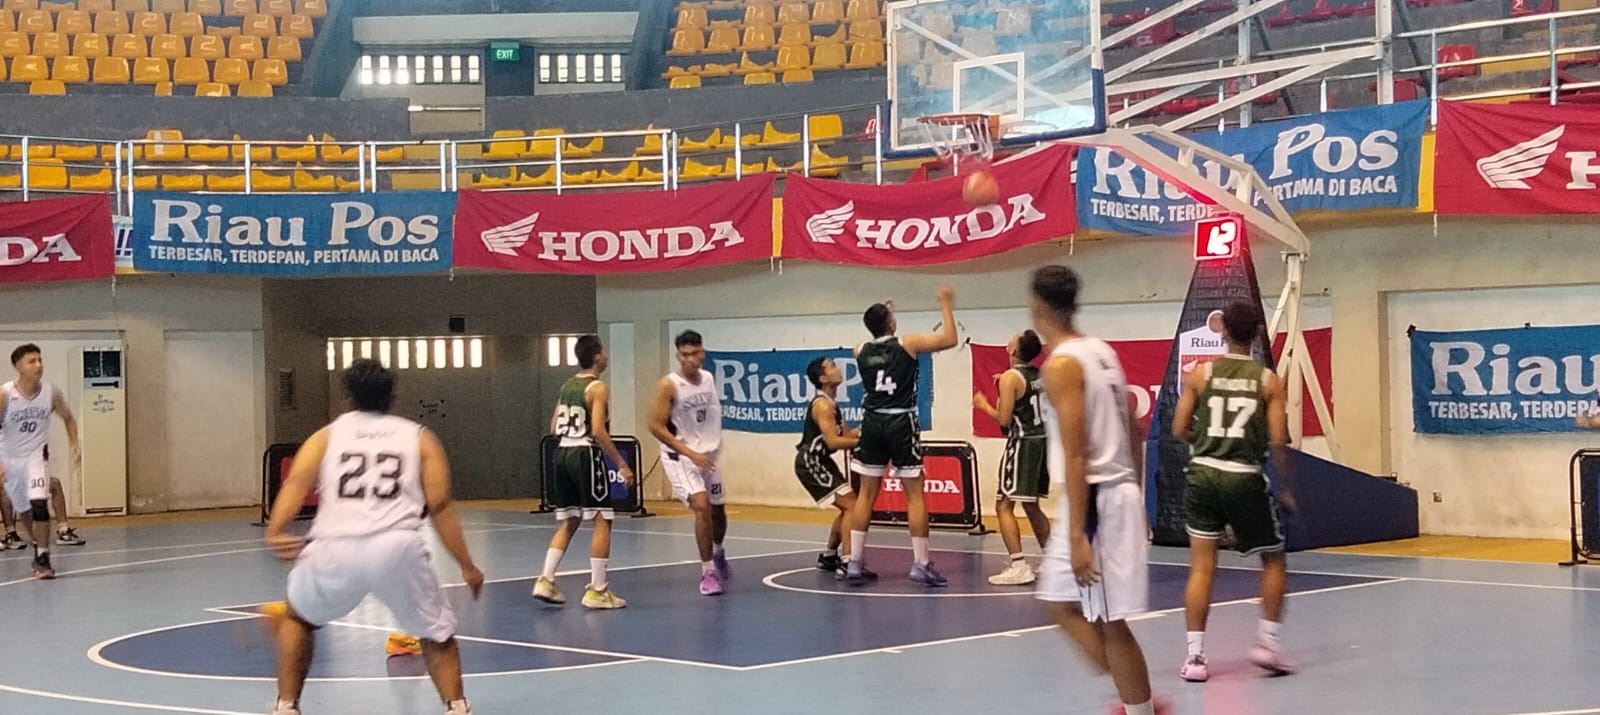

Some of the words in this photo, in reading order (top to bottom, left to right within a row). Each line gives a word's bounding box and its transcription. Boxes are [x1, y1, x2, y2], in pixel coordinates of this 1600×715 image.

[496, 49, 514, 60] EXIT
[1268, 123, 1399, 180] Pos
[1090, 199, 1165, 224] TERBESAR,
[1254, 178, 1324, 206] PRTAMA
[1328, 178, 1345, 196] DI
[1349, 175, 1398, 195] BACA
[150, 199, 307, 246] Riau
[327, 201, 439, 246] Pos
[855, 193, 1046, 250] HONDA
[1206, 221, 1237, 255] 12
[148, 245, 228, 264] TERBESAR,
[230, 249, 310, 266] TERDEPAN,
[313, 248, 381, 264] PERTAMA
[383, 249, 399, 263] DI
[402, 247, 439, 263] BACA
[538, 220, 744, 262] HONDA
[1191, 337, 1219, 348] Riau
[713, 359, 816, 403] Riau
[875, 370, 897, 395] 4
[1429, 341, 1600, 396] Riau
[555, 404, 587, 438] 23
[766, 407, 807, 421] TERDEP
[1207, 395, 1258, 438] 17
[1428, 401, 1518, 420] TERBESAR,
[338, 452, 402, 499] 23
[883, 479, 960, 493] HDA
